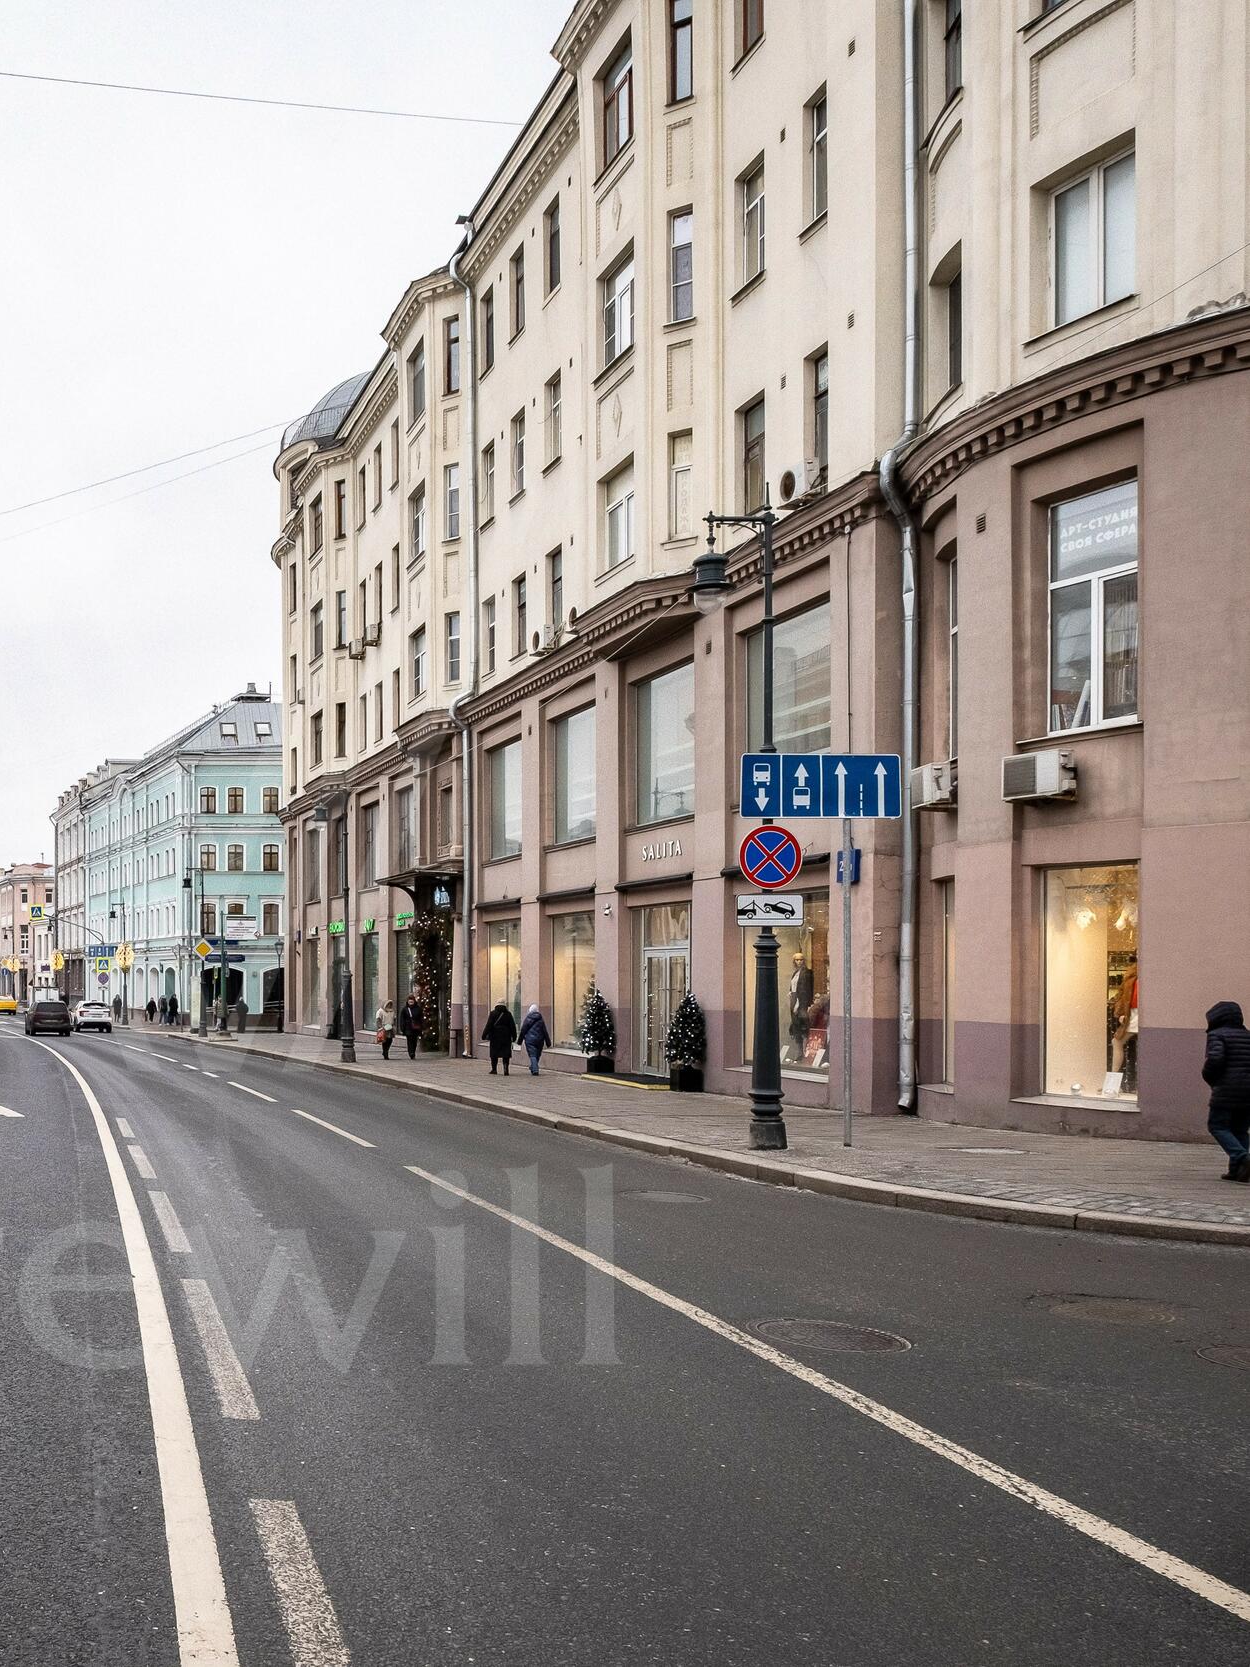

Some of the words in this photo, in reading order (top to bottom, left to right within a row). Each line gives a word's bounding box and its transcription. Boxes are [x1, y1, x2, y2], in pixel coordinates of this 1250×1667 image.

[1060, 505, 1137, 540] АРТ-СТУДИЯ
[1060, 535, 1092, 554] СВОЯ
[1095, 522, 1136, 544] СФЕРА
[642, 839, 682, 862] SALITA
